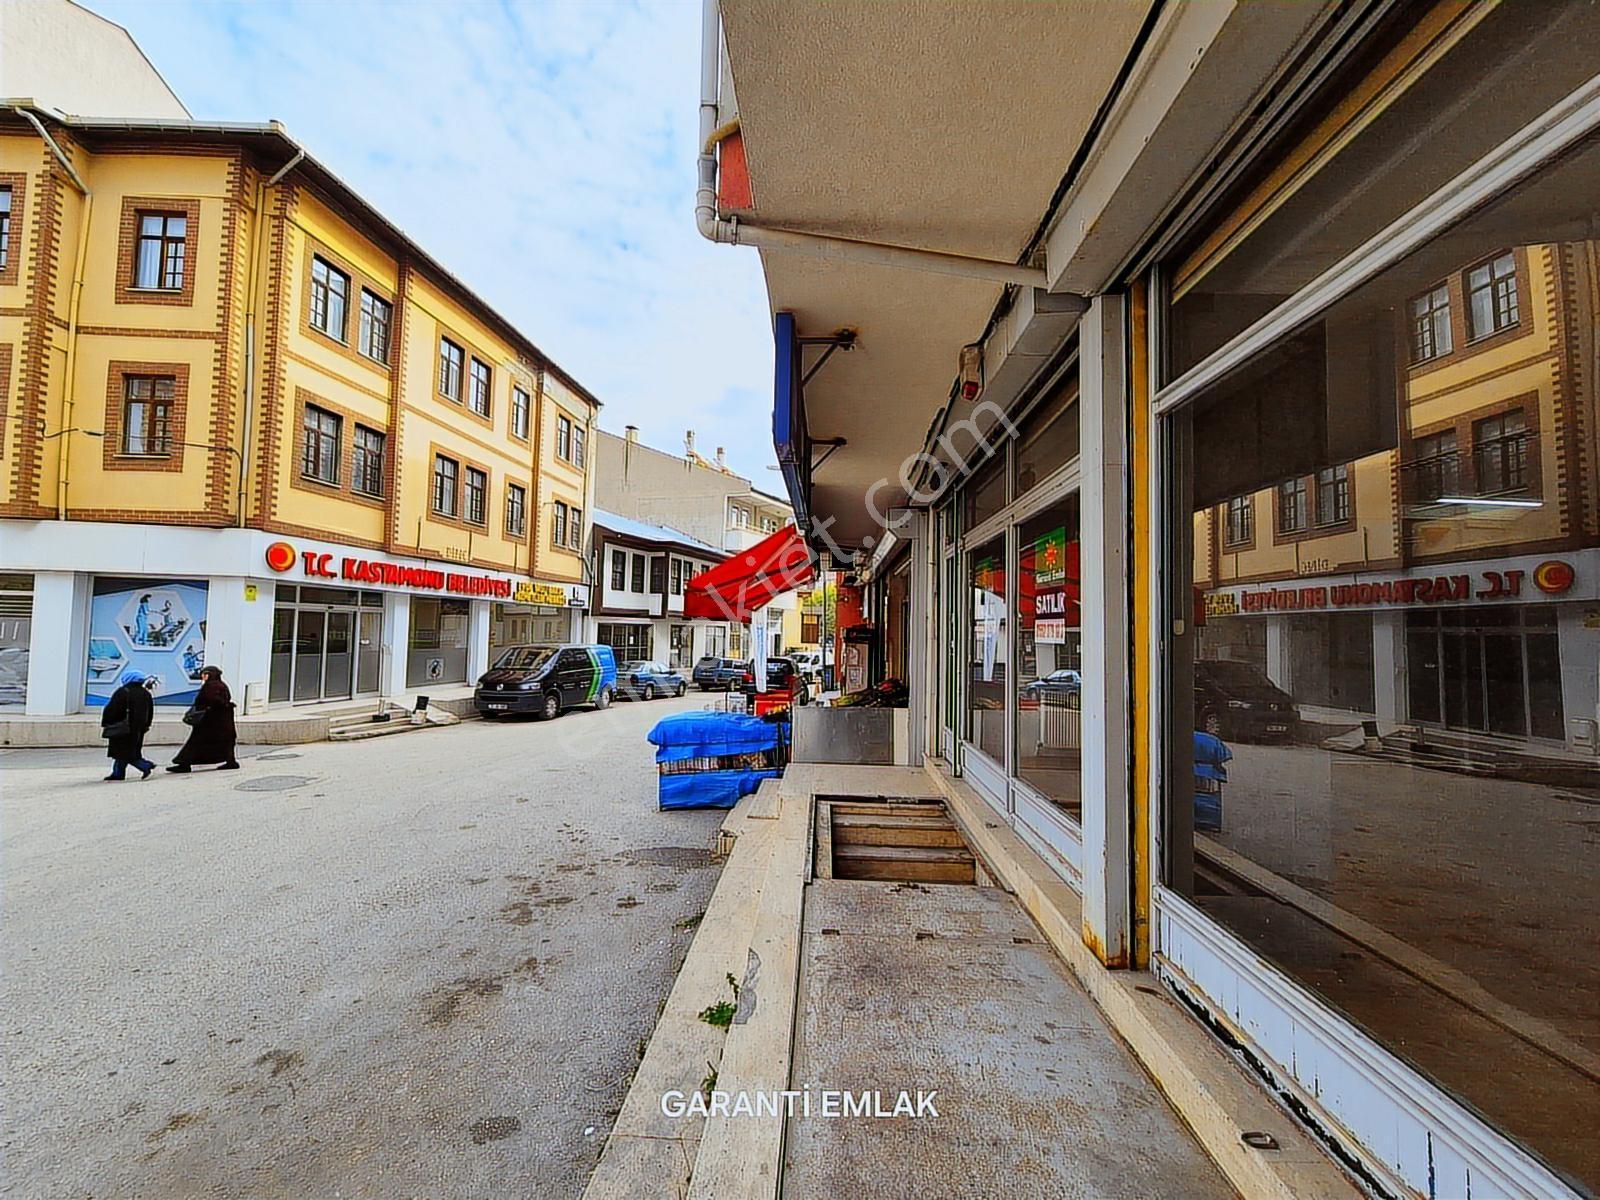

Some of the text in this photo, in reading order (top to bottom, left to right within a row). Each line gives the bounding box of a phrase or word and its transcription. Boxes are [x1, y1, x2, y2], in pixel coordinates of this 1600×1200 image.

[302, 552, 337, 579] T.C.
[342, 558, 445, 590] KASTAMONU
[447, 572, 512, 597] BELEDİYESİ
